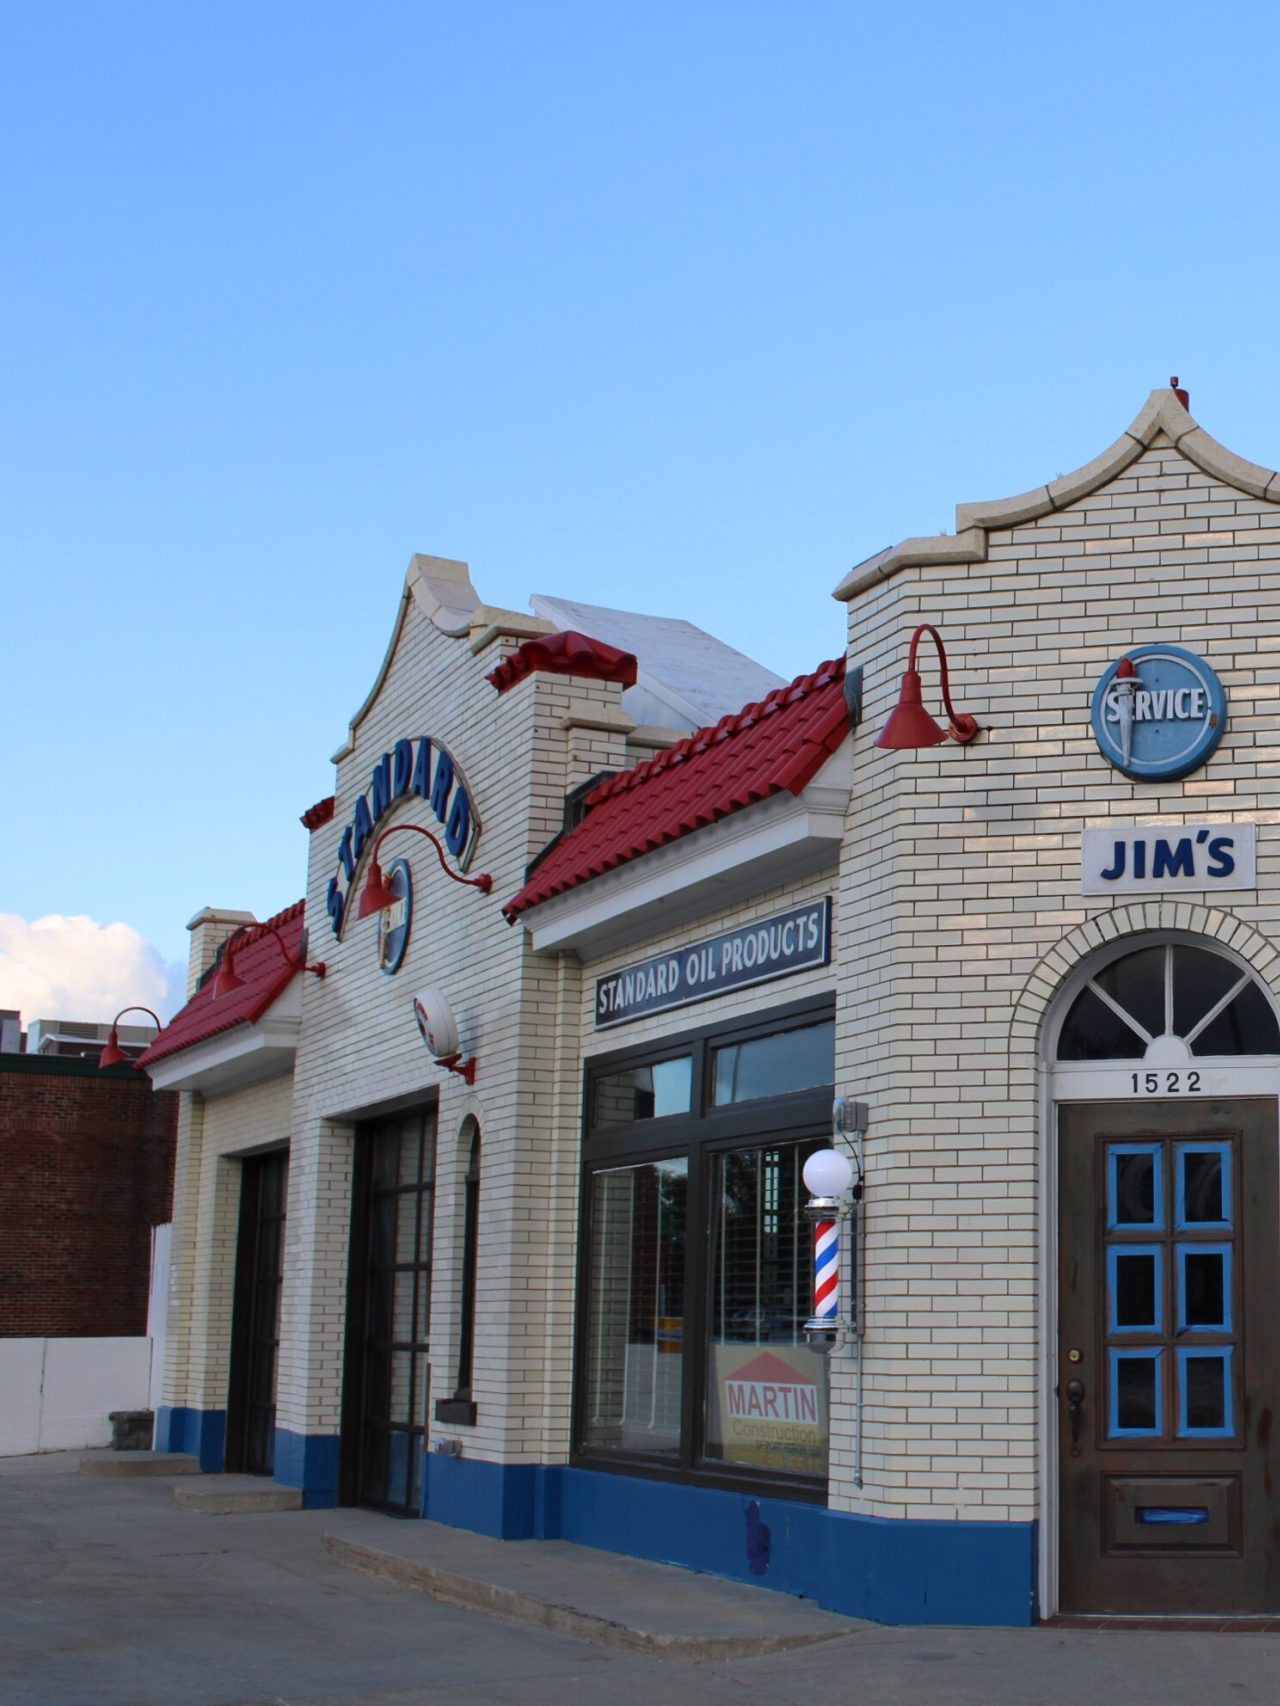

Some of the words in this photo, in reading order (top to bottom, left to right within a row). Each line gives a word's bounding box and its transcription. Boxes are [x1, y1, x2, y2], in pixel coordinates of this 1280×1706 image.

[1106, 688, 1204, 722] SRVICE
[327, 735, 470, 934] STANDARD
[1100, 829, 1236, 881] JIM'S
[599, 959, 680, 1015] STANDARD
[686, 945, 716, 986] OIL
[721, 911, 819, 976] PRODUCTS
[1131, 1071, 1201, 1094] 1522
[727, 1383, 817, 1422] MARTIN
[732, 1419, 817, 1444] Construction
